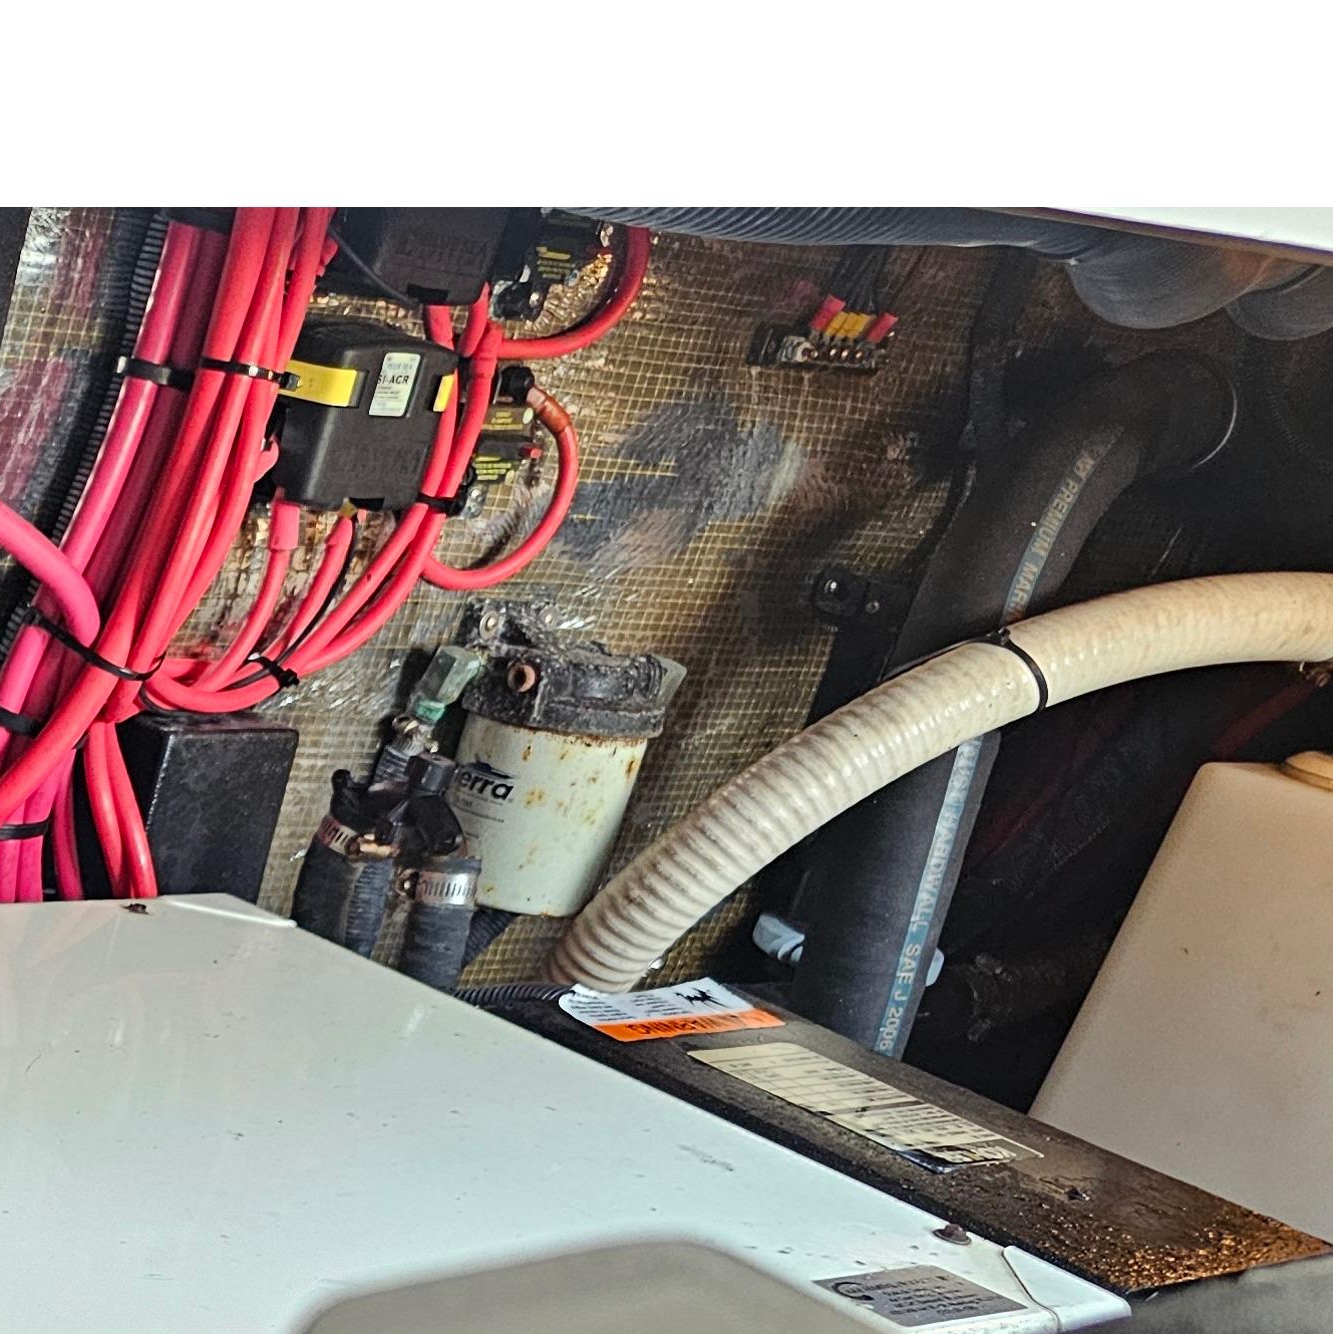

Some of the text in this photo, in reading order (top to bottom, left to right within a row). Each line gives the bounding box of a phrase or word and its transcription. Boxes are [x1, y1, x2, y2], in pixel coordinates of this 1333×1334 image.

[1029, 476, 1079, 558] PREMIUM
[910, 810, 960, 935] HARDWALL
[896, 940, 922, 987] SAE
[891, 987, 909, 1004] J
[876, 1004, 903, 1053] 2006
